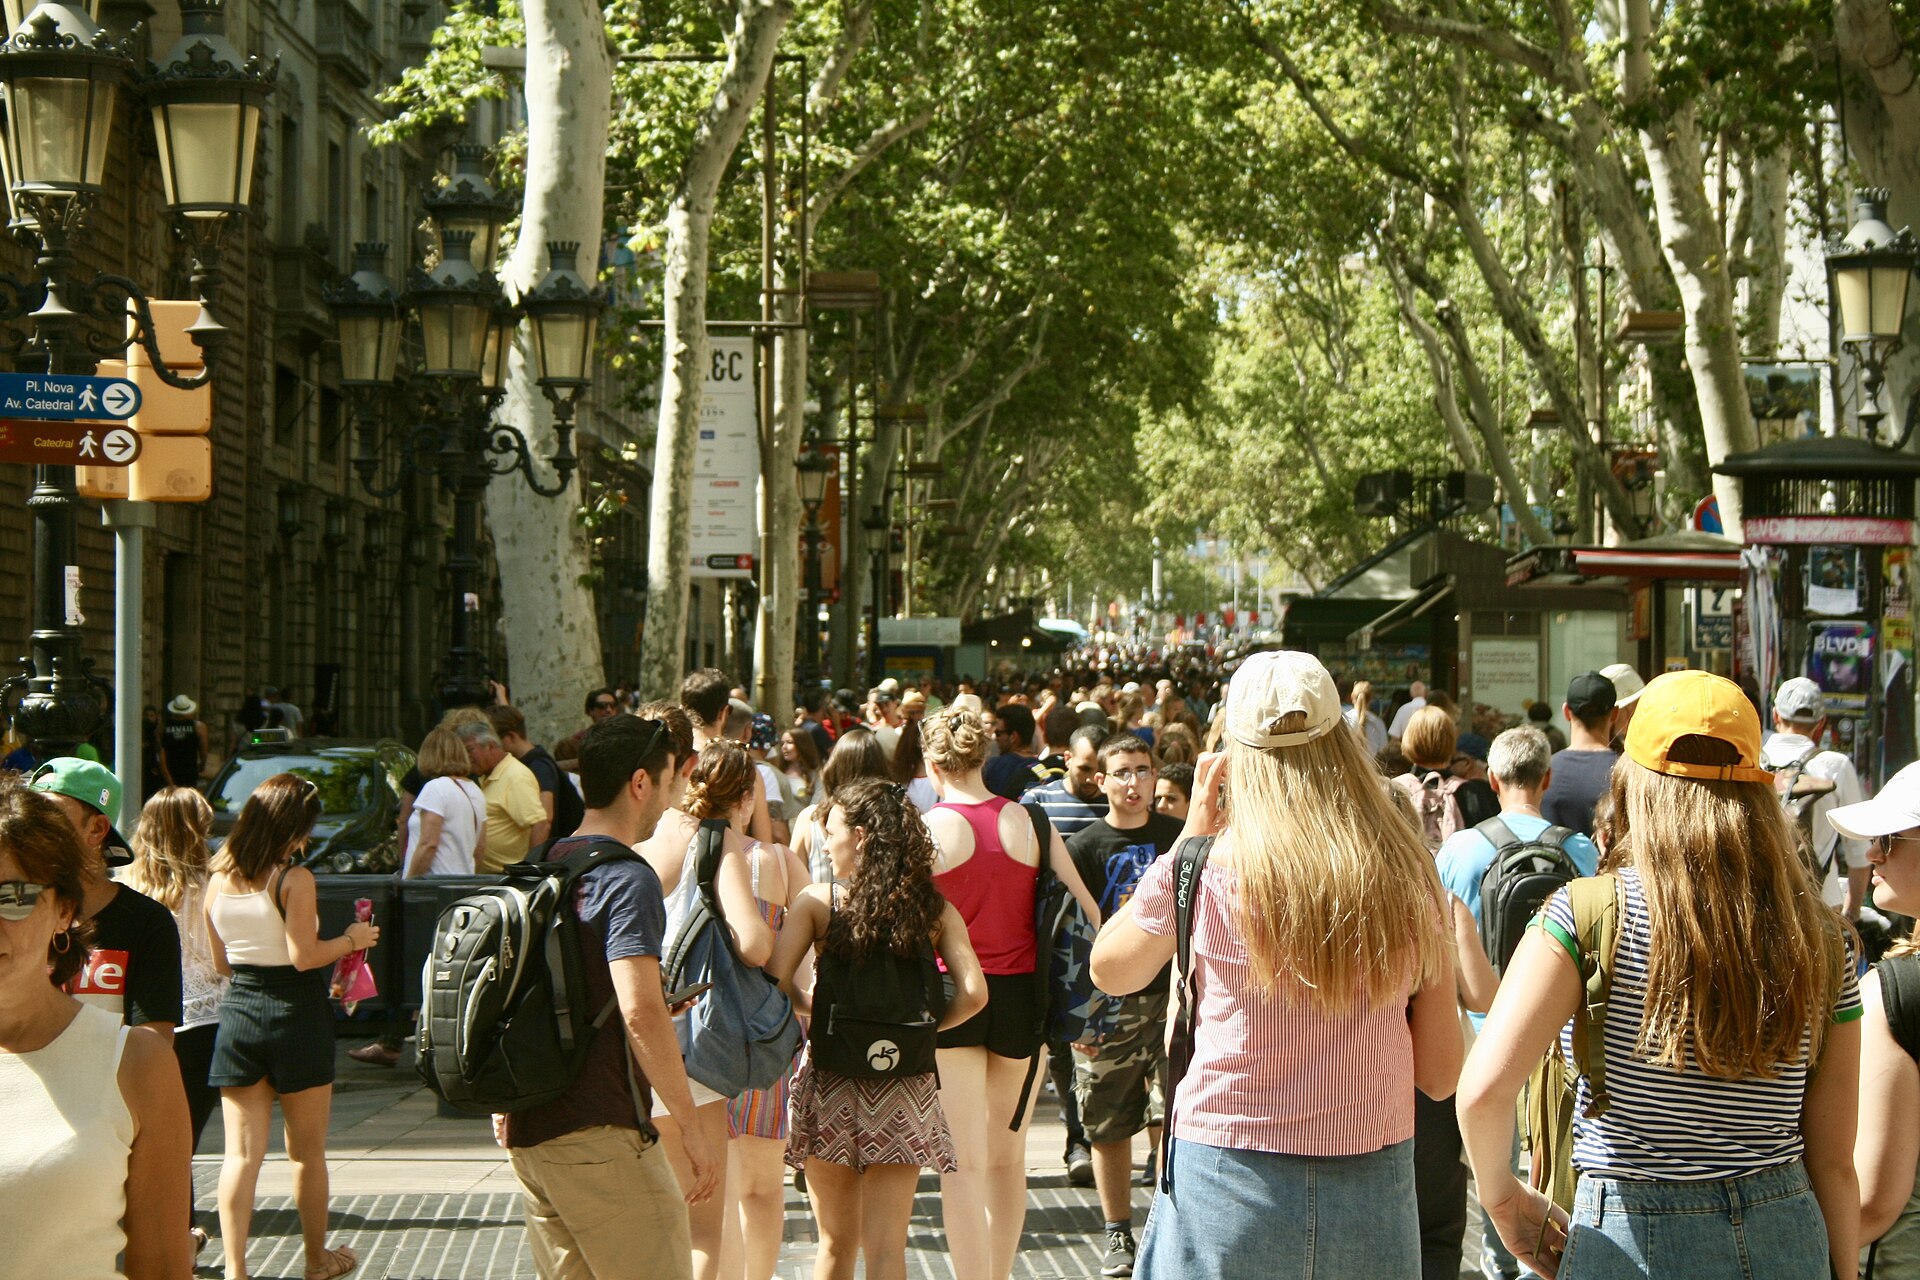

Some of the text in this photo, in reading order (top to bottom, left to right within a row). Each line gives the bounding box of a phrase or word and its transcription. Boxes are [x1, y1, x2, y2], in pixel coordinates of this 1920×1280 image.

[26, 380, 74, 393] Pl. Nova
[4, 397, 74, 411] Av. Catedral
[33, 437, 74, 448] Catedral
[1814, 636, 1861, 653] BLVD
[1138, 847, 1147, 864] 8
[1178, 861, 1193, 907] DAKINE
